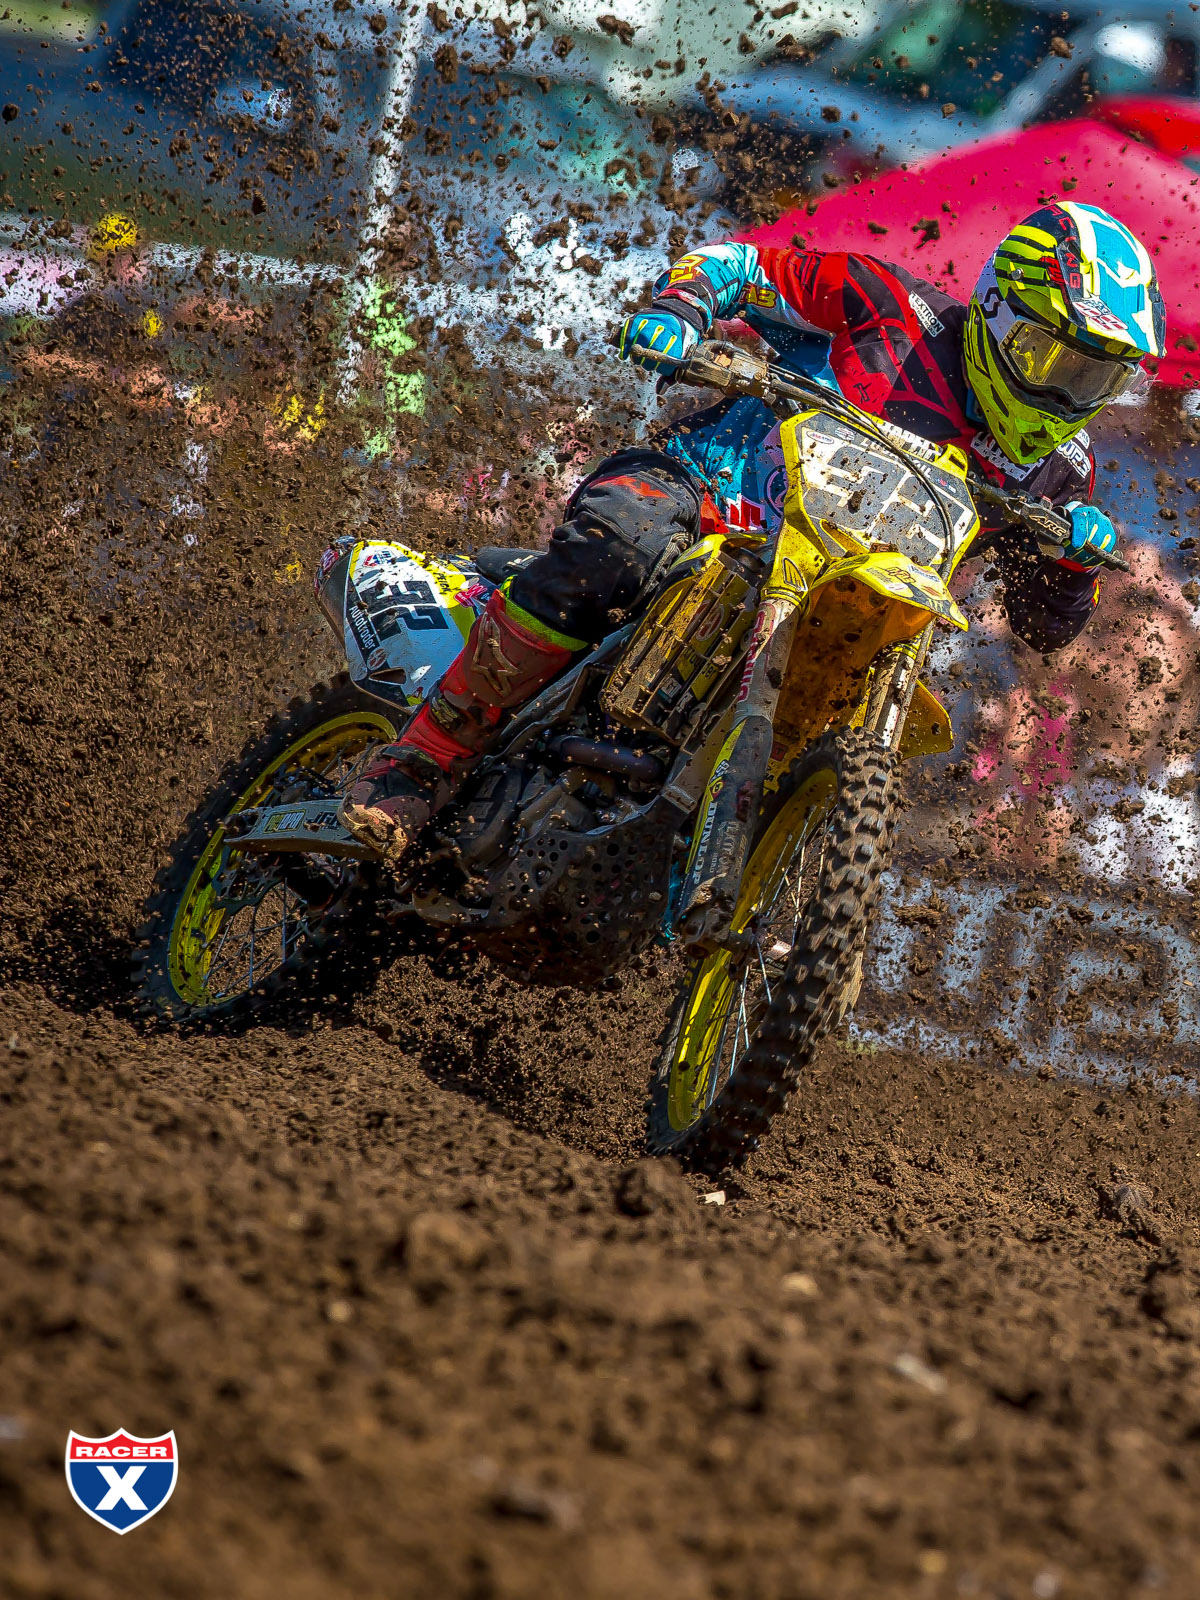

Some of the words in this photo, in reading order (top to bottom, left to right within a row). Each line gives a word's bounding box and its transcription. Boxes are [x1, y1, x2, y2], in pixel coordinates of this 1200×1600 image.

[1045, 206, 1080, 288] ACING
[911, 290, 944, 333] TEXTRON
[1029, 515, 1067, 536] ARC
[349, 606, 376, 650] Autotrader
[693, 800, 718, 884] DUNLOP
